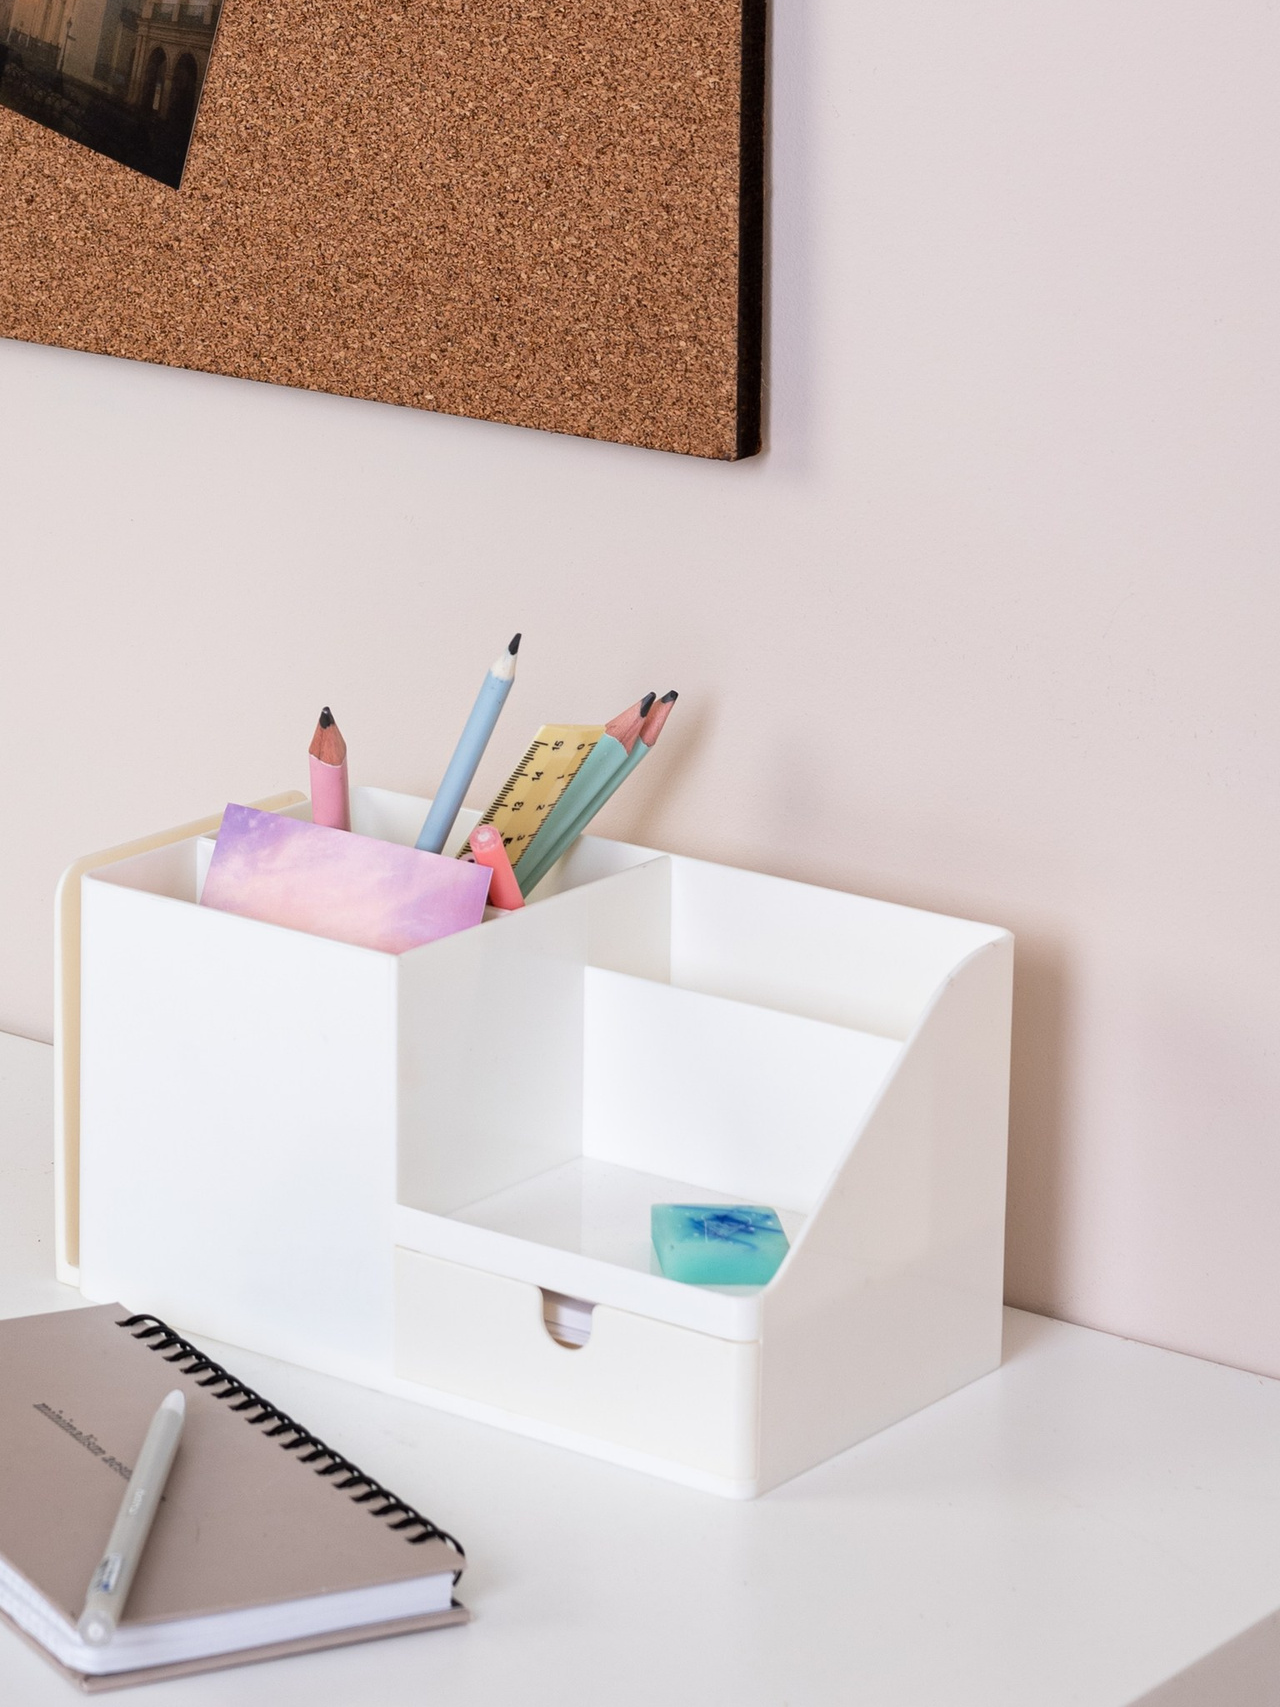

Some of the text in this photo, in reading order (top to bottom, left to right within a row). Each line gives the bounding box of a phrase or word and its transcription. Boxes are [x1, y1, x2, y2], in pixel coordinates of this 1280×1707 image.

[552, 740, 564, 751] 15
[531, 770, 544, 781] 14
[511, 801, 524, 812] 13
